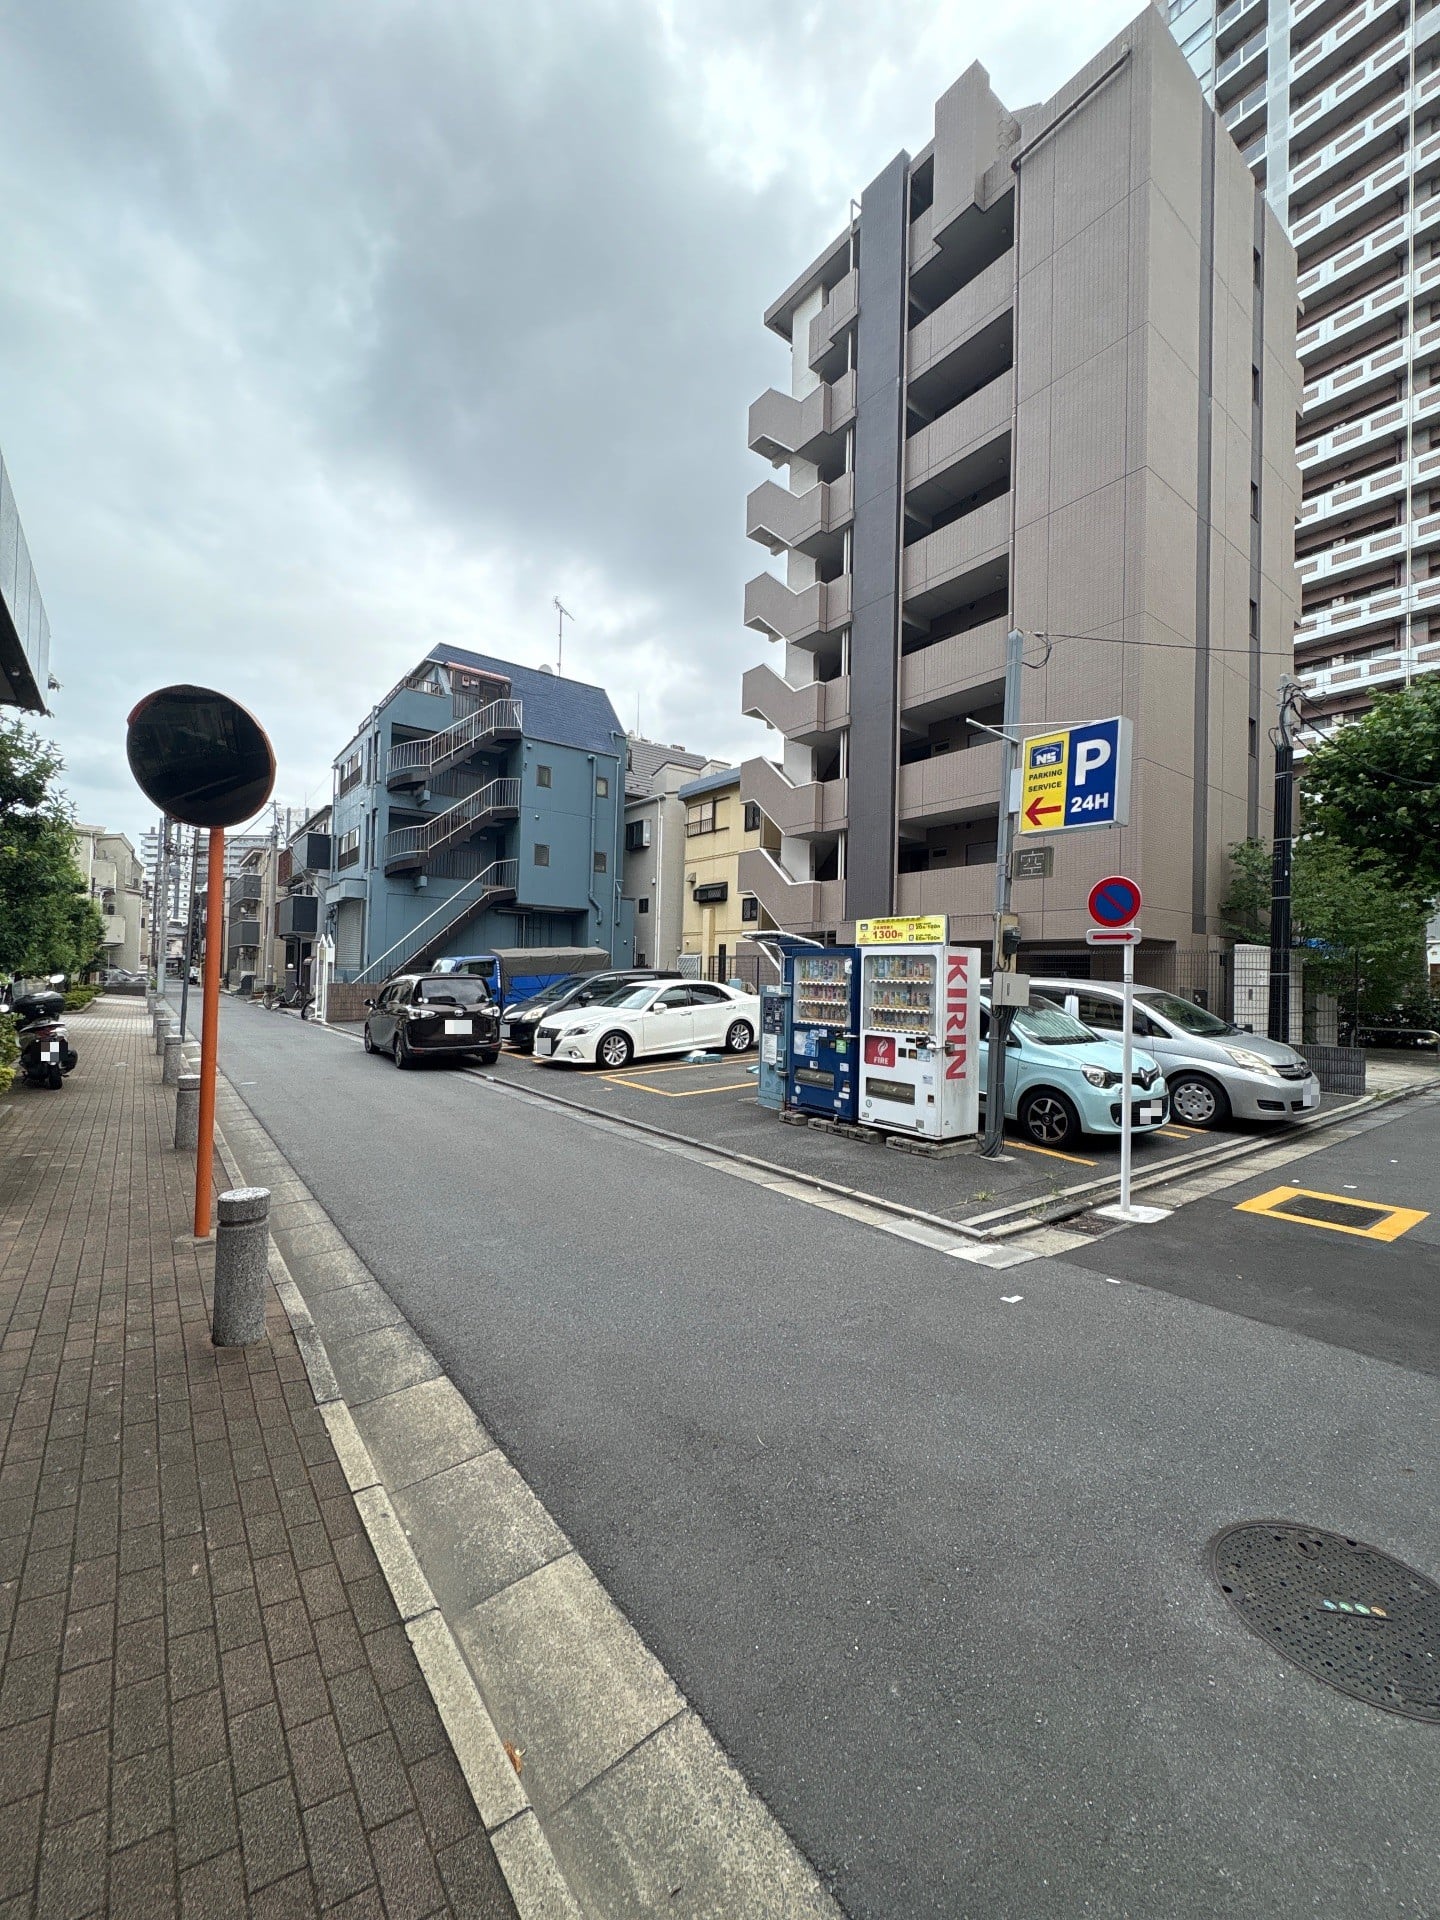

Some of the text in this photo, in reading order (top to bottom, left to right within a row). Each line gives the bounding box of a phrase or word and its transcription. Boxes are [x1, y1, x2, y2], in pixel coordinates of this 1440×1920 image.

[1036, 752, 1056, 765] NS
[1075, 739, 1111, 786] P
[1028, 768, 1063, 781] PARKING
[1028, 780, 1062, 793] SERVICE
[1070, 791, 1109, 814] 24H
[1019, 850, 1045, 877] 空
[872, 929, 904, 940] 1300円
[946, 955, 968, 1080] KIRIN
[873, 1056, 889, 1065] FIRE
